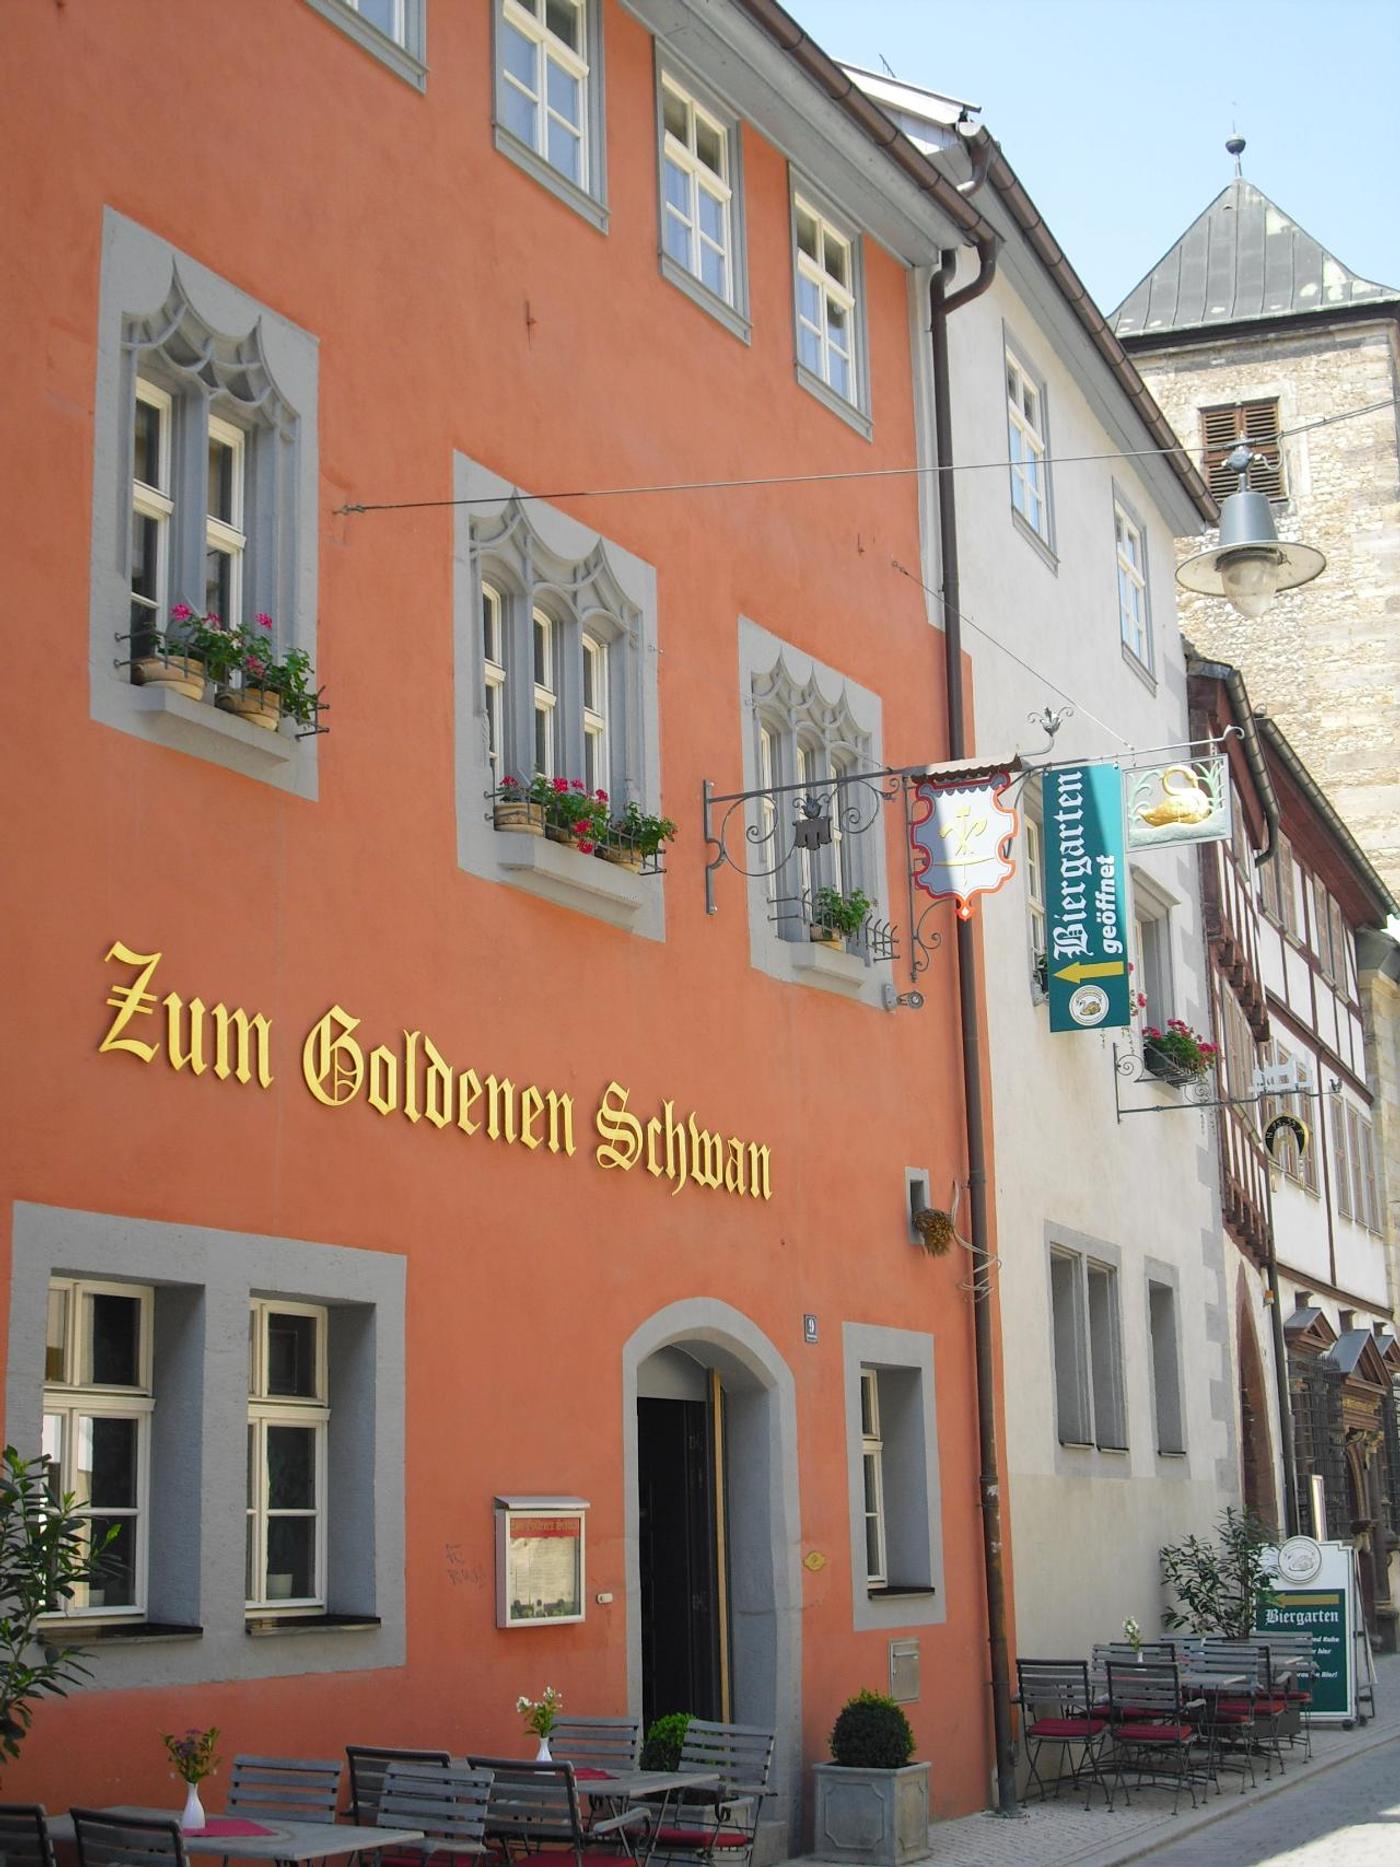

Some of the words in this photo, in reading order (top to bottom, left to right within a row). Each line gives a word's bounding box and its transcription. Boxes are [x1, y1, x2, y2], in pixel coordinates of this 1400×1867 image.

[1053, 770, 1094, 960] Biergarten
[1095, 854, 1123, 954] geöffnet
[100, 941, 273, 1089] Zum
[302, 1004, 577, 1157] Goldenen
[596, 1081, 773, 1200] Schwan
[1264, 1608, 1339, 1626] Biergarten
